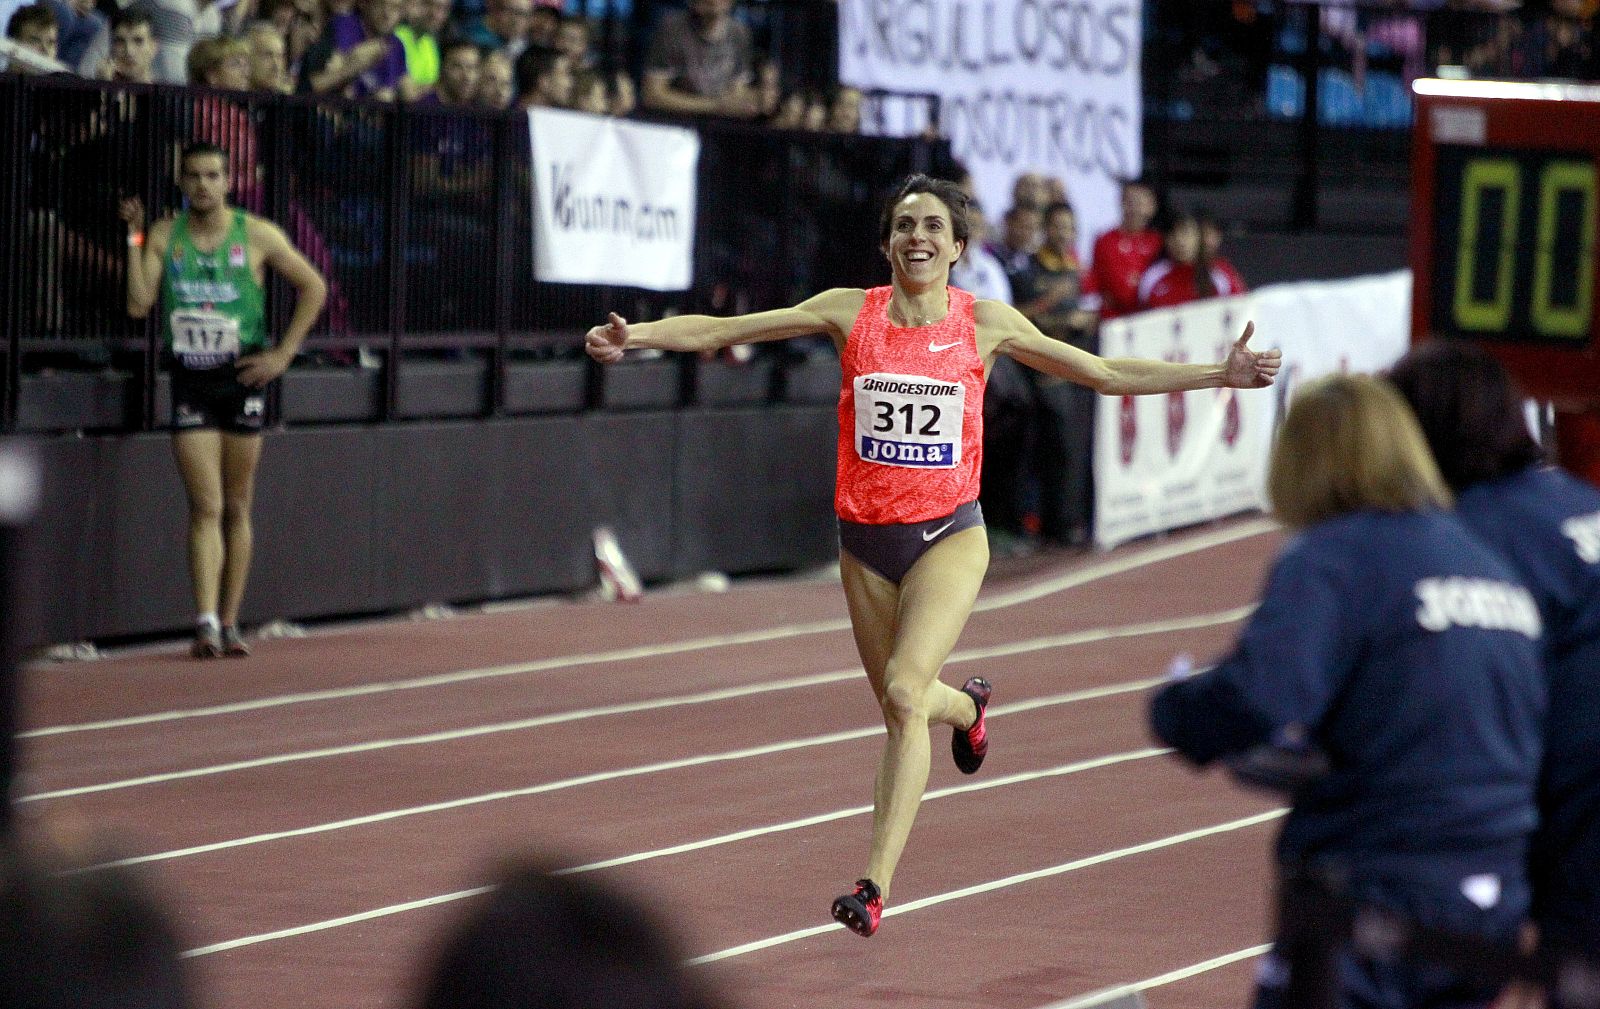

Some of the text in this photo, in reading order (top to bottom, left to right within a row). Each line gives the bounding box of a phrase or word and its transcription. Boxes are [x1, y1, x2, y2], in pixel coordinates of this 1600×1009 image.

[187, 327, 224, 349] 117
[862, 378, 958, 396] BRIDGESTONE
[873, 401, 941, 436] 312
